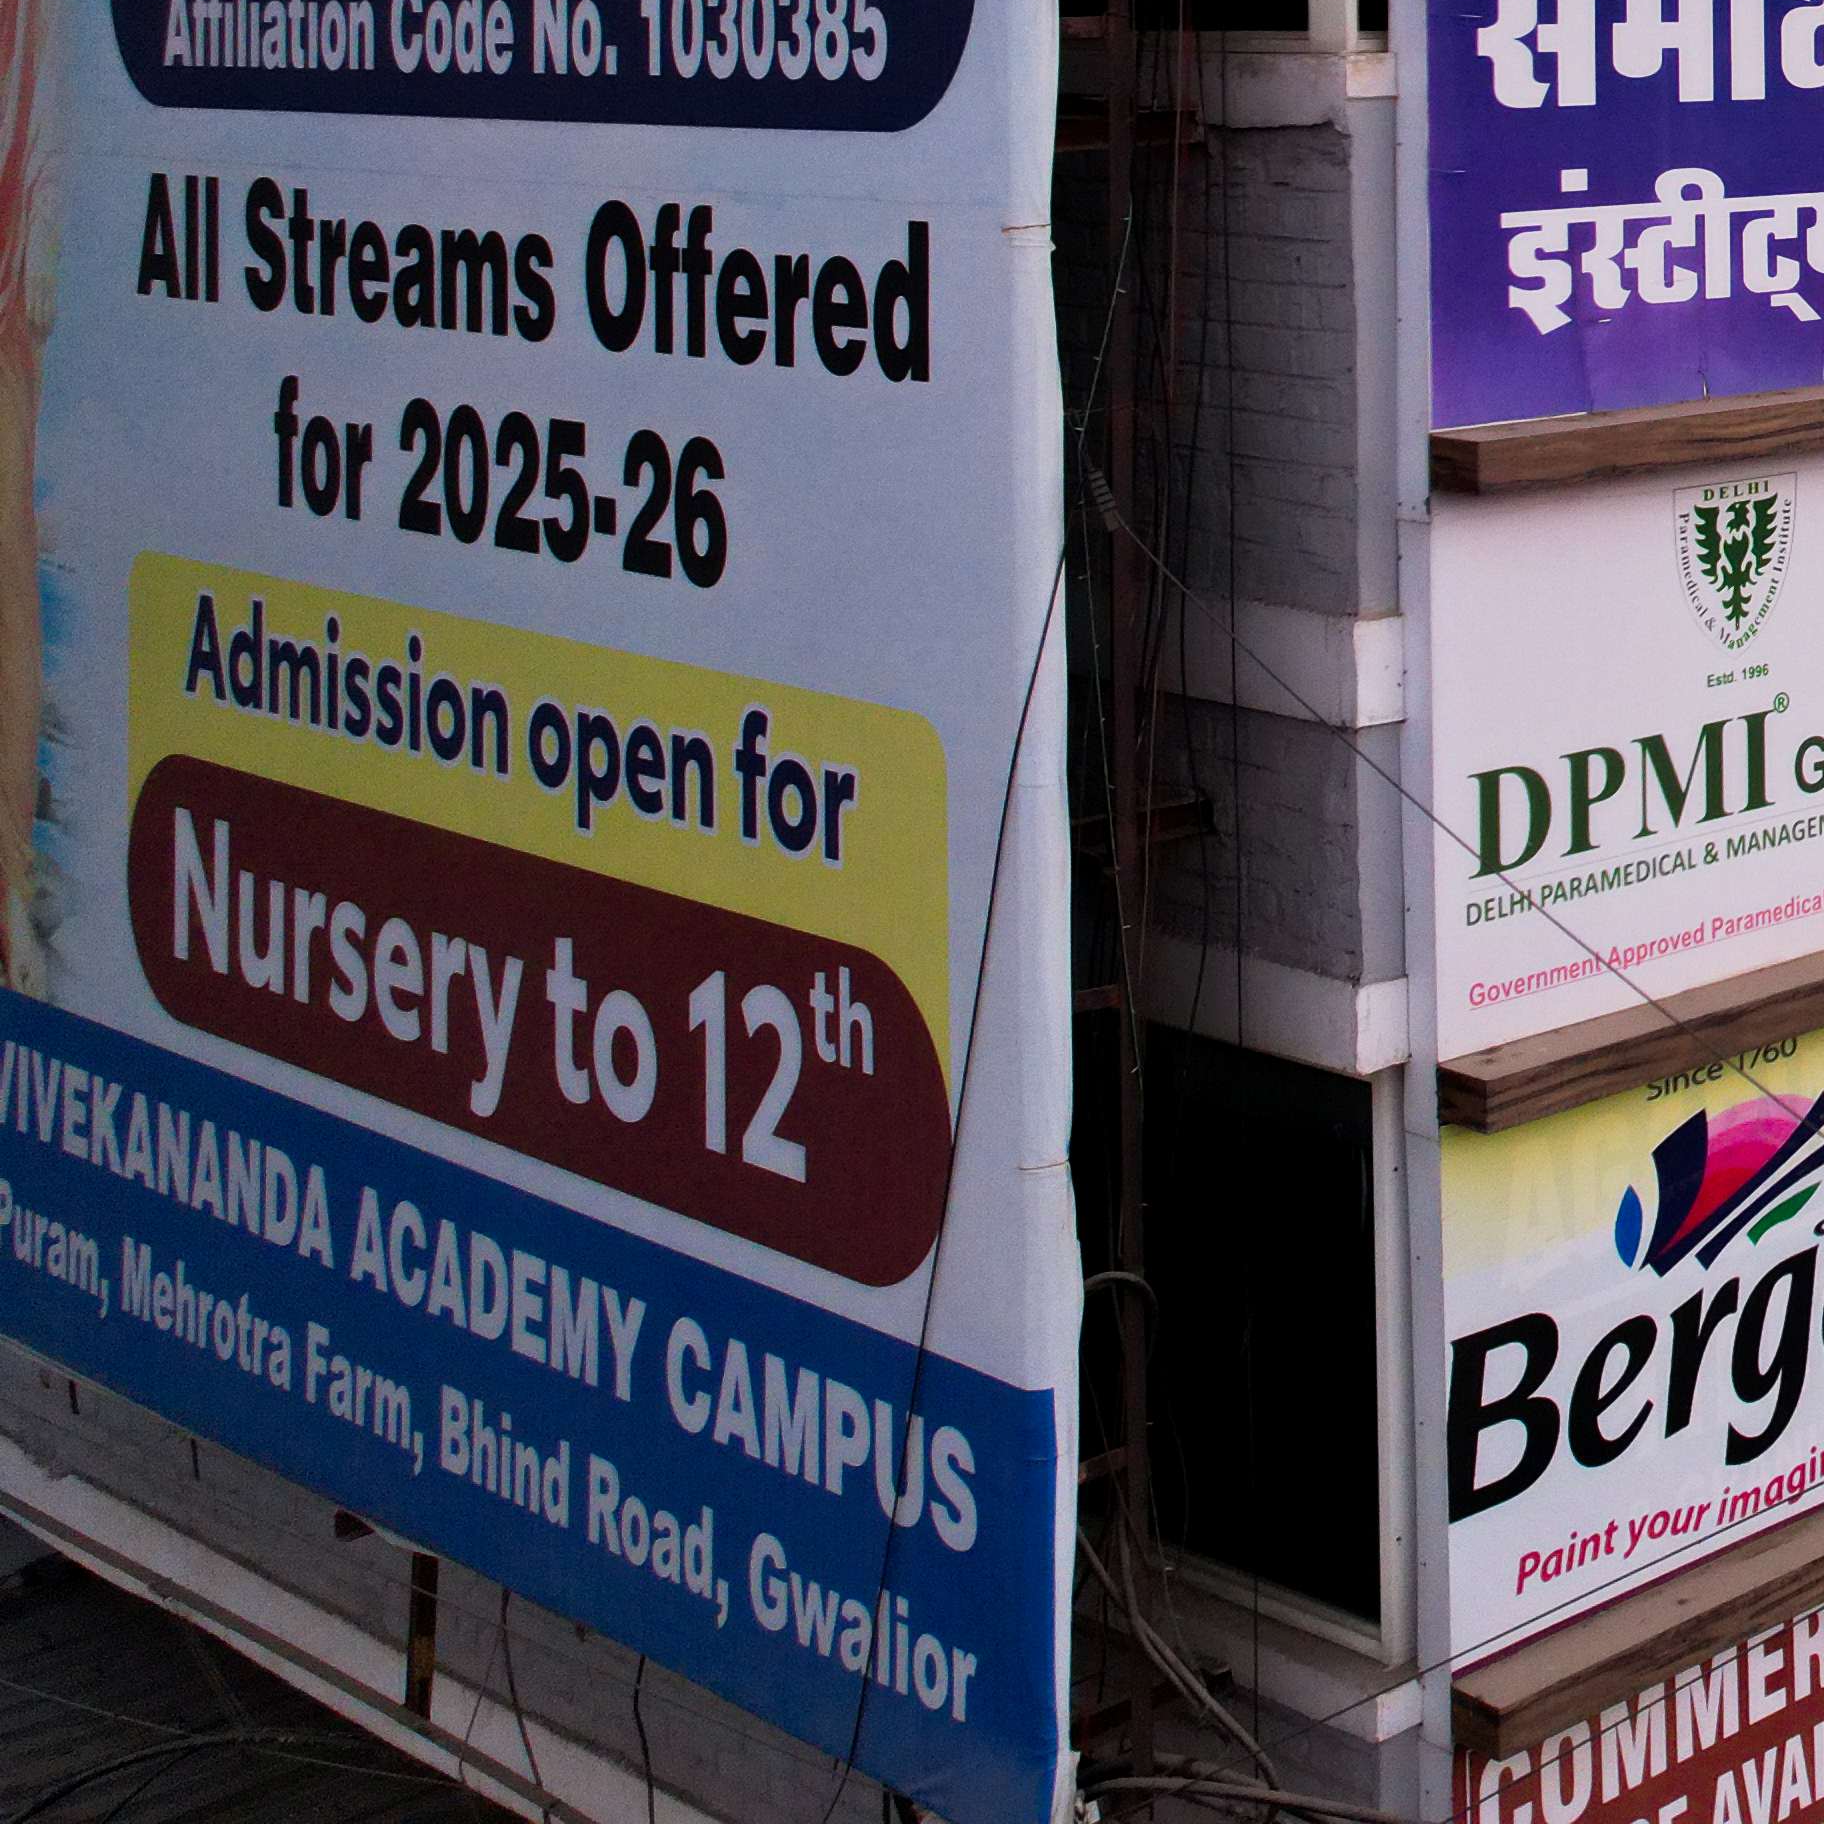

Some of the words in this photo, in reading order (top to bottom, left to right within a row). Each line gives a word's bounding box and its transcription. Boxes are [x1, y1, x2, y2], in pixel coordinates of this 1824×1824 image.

[137, 172, 219, 304] All
[244, 177, 555, 343] Streams
[586, 200, 930, 383] Offered
[274, 376, 372, 521] for
[399, 398, 728, 589] 2025-26
[1703, 481, 1769, 501] DELHI
[1679, 513, 1708, 617] Paramedical
[1705, 617, 1716, 631] &
[1720, 579, 1780, 650] Management
[1773, 498, 1792, 573] Institute
[186, 594, 509, 774] Admission
[528, 701, 714, 830] open
[735, 710, 855, 862] for
[1707, 672, 1737, 688] Estd.
[1741, 664, 1769, 681] 1996
[1468, 708, 1777, 880] DPMI
[1466, 890, 1534, 927] DELHI
[1540, 850, 1697, 907] PARAMEDICAL
[1703, 843, 1719, 865] &
[1469, 953, 1604, 1008] Government
[1607, 922, 1705, 972] Approved
[172, 807, 522, 1117] Nursery
[546, 937, 657, 1123] to
[688, 966, 874, 1183] 12th
[1646, 1057, 1724, 1101] Since
[0, 1040, 332, 1268] VIVEKANANDA
[350, 1186, 644, 1400] ACADEMY
[668, 1316, 978, 1553] CAMPUS
[120, 1236, 291, 1387] Mehrotra
[306, 1322, 425, 1475] Farm,
[440, 1385, 570, 1528] Bhind
[588, 1454, 729, 1630] Road,
[749, 1533, 977, 1722] Gwalior
[1516, 1520, 1620, 1595] Paint
[1628, 1504, 1712, 1557] your
